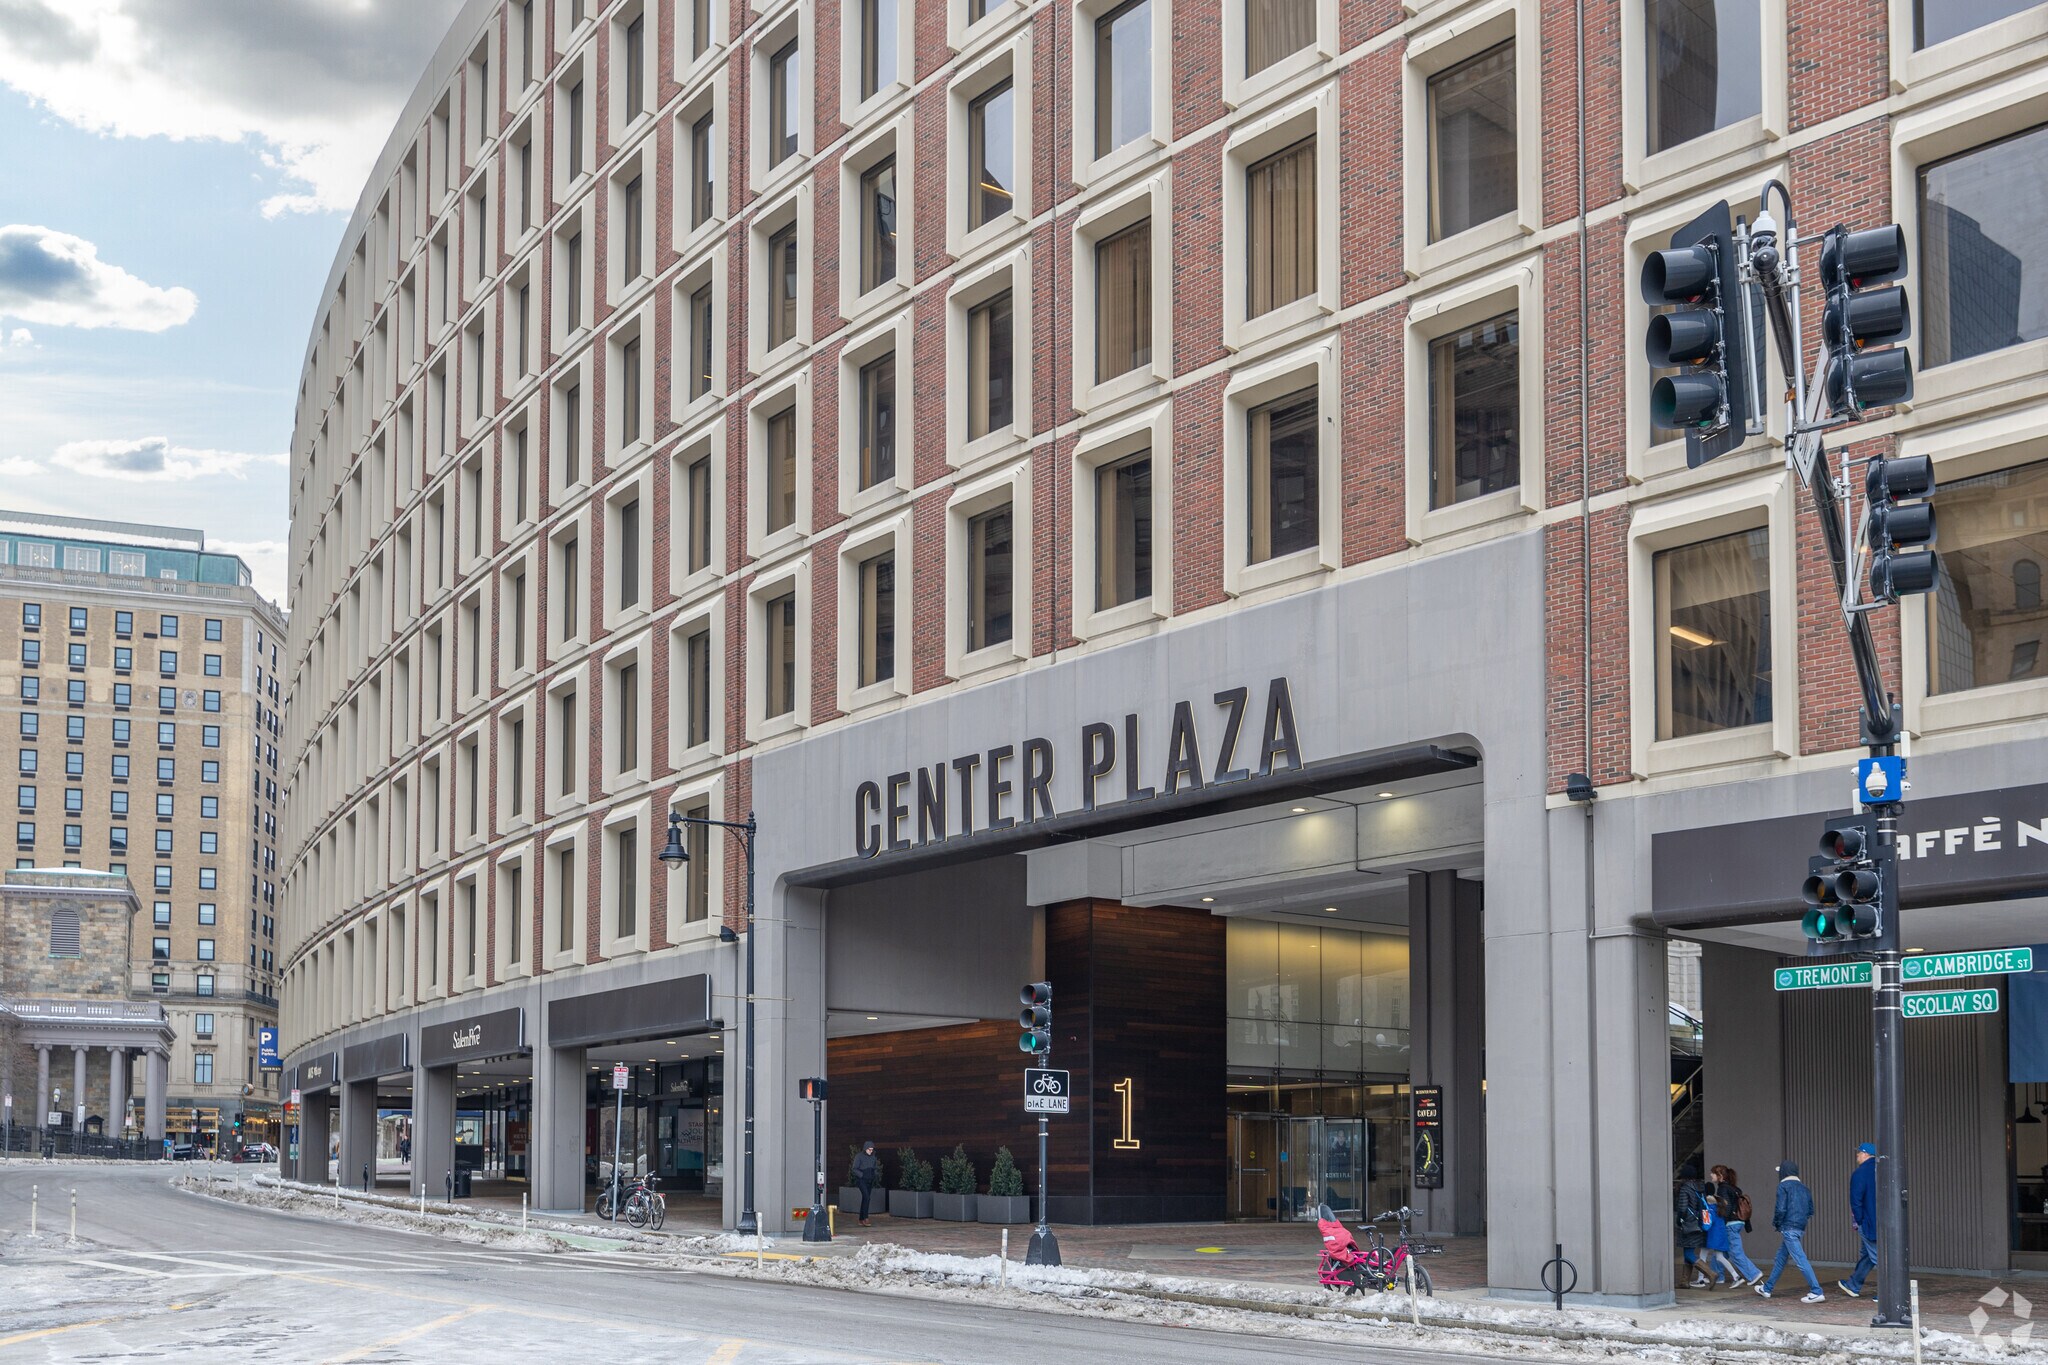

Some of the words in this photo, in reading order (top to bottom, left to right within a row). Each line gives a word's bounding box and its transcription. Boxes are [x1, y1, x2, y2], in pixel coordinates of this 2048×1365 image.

[855, 737, 1057, 859] CENTER
[1081, 677, 1304, 812] PLAZA
[1896, 816, 2001, 860] AFFÈ
[1795, 966, 1858, 986] TREMONT
[1860, 972, 1869, 982] ST
[1923, 952, 2014, 976] CAMBRIDGE
[2017, 958, 2029, 969] ST
[1906, 995, 1967, 1016] SCOLLAY
[1972, 993, 1993, 1012] SQ
[261, 1032, 272, 1045] P
[453, 1025, 481, 1049] SalemFive
[1048, 1098, 1067, 1109] LANE
[1114, 1077, 1140, 1149] 1
